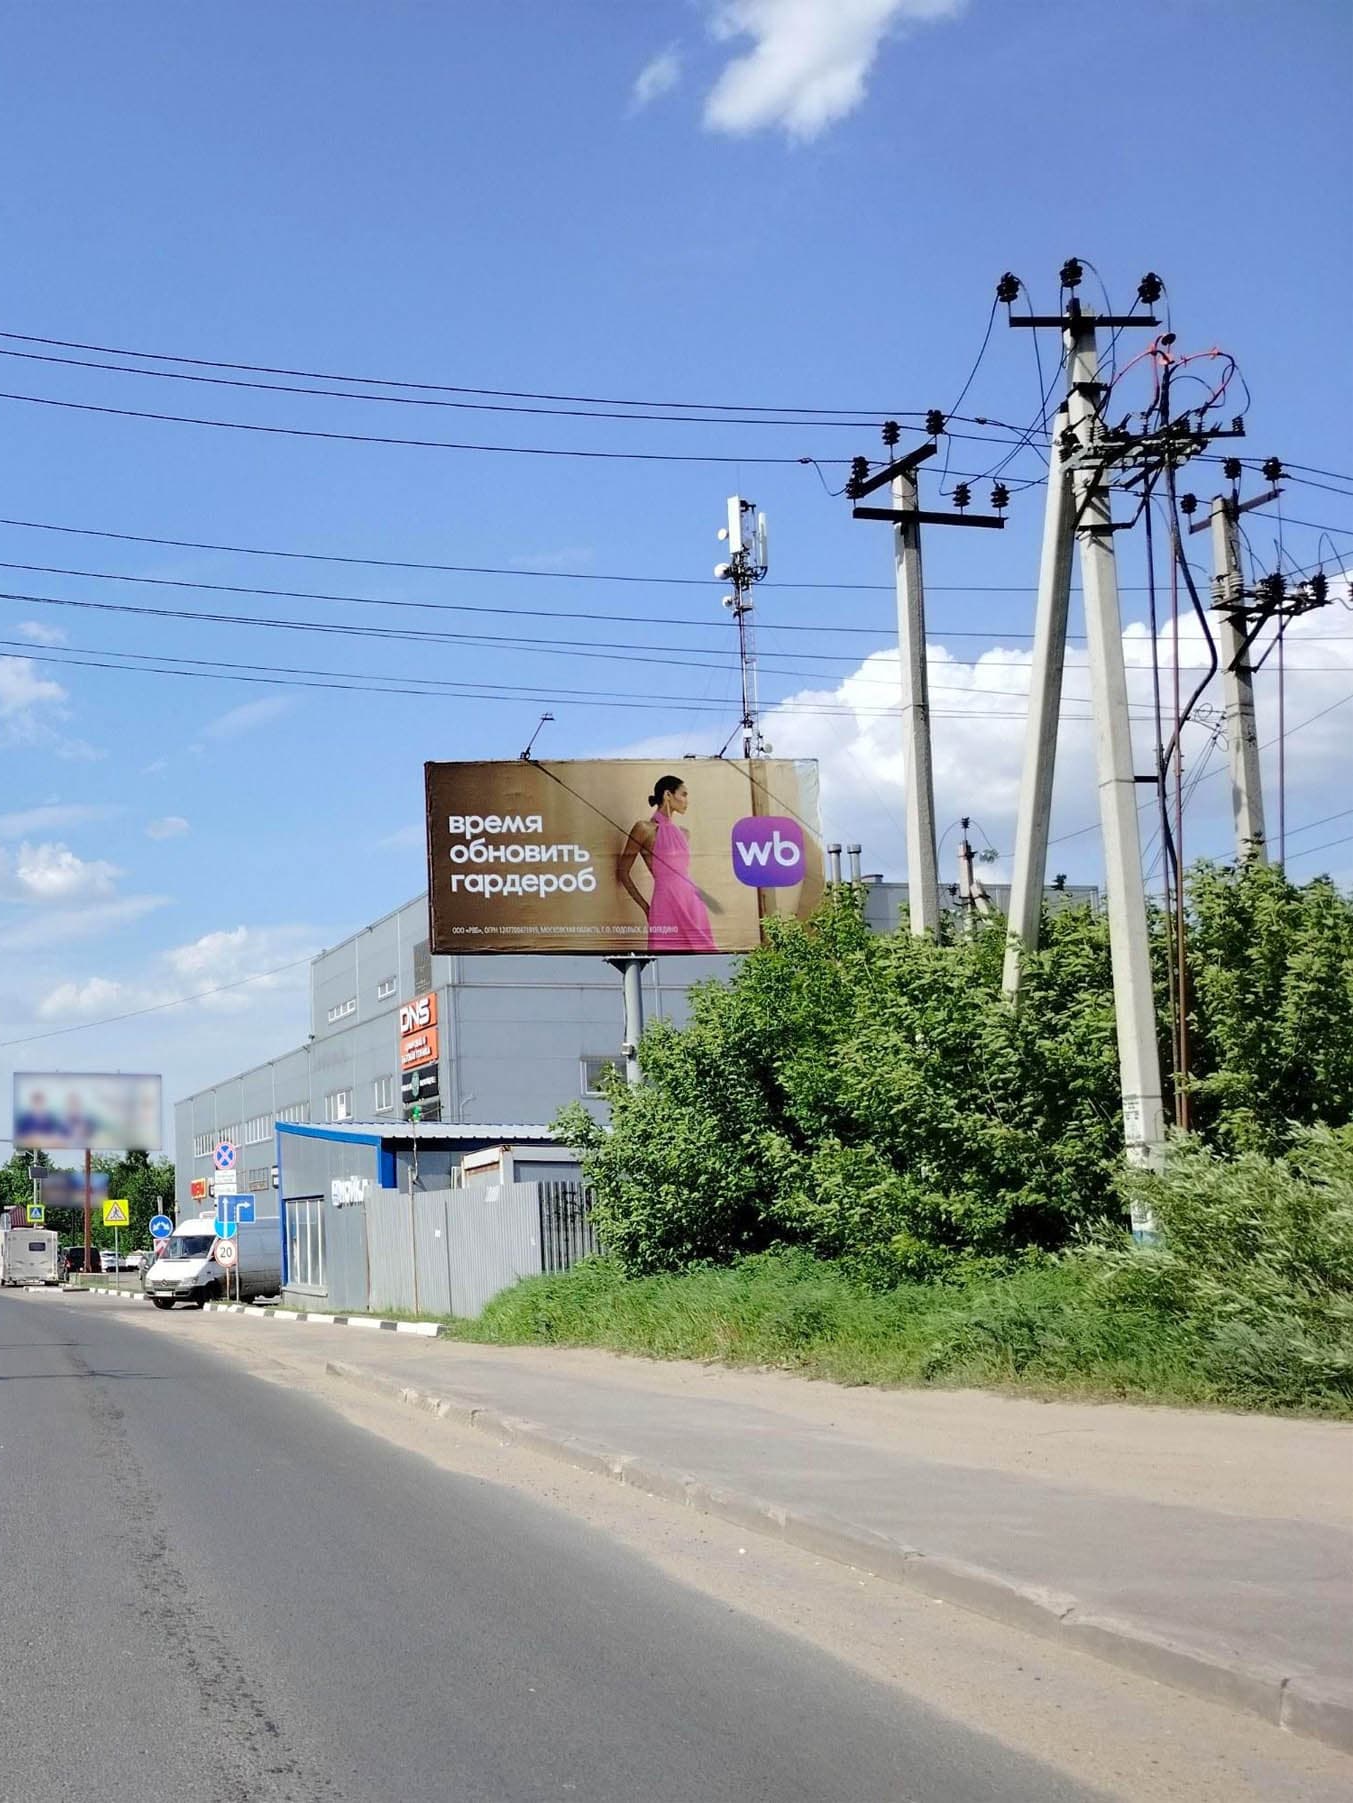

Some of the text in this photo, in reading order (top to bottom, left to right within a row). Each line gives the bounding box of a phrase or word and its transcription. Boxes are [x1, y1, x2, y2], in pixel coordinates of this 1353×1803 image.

[448, 815, 543, 840] время
[449, 837, 591, 864] обновить
[735, 830, 801, 867] wb
[450, 866, 597, 899] гардероб
[399, 997, 431, 1034] DNS
[219, 1246, 233, 1258] 20
